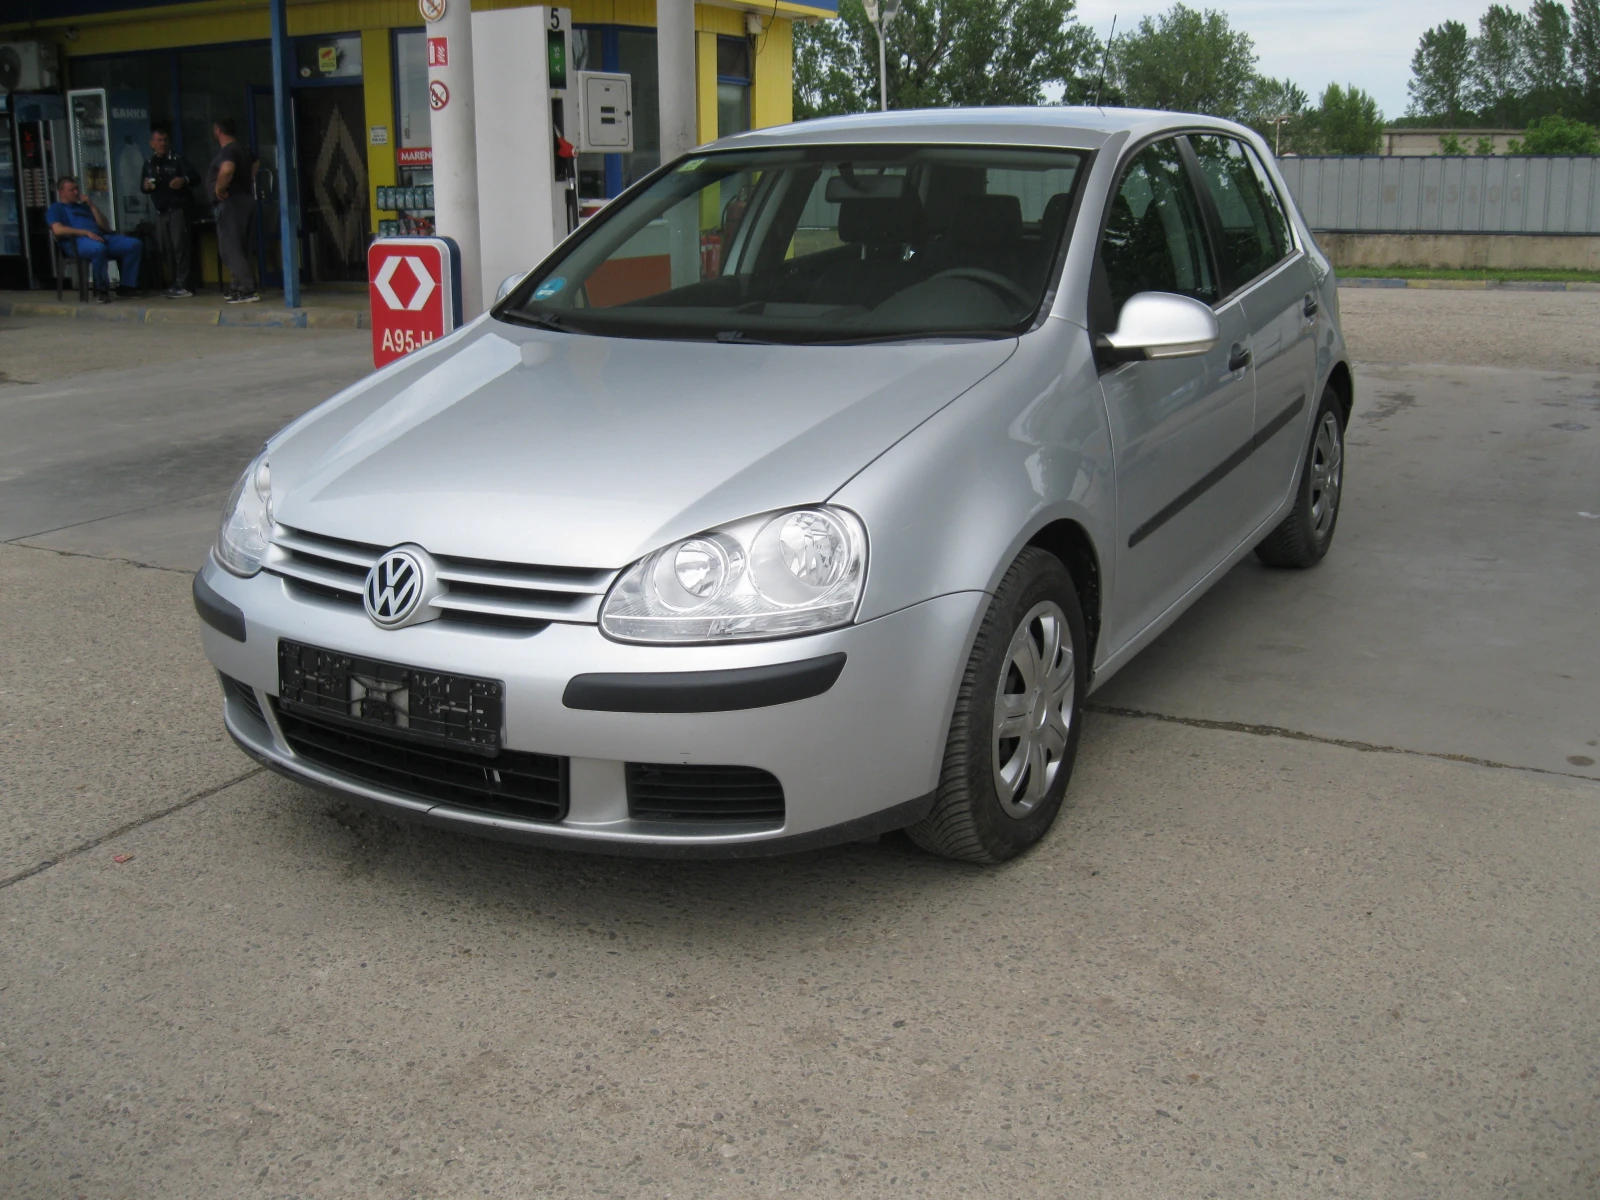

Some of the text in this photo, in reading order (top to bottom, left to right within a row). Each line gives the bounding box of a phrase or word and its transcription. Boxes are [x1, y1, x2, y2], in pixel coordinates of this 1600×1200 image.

[551, 7, 560, 30] 5
[112, 107, 148, 119] БАНКЯ
[401, 150, 433, 161] MAREN
[367, 554, 419, 621] VW
